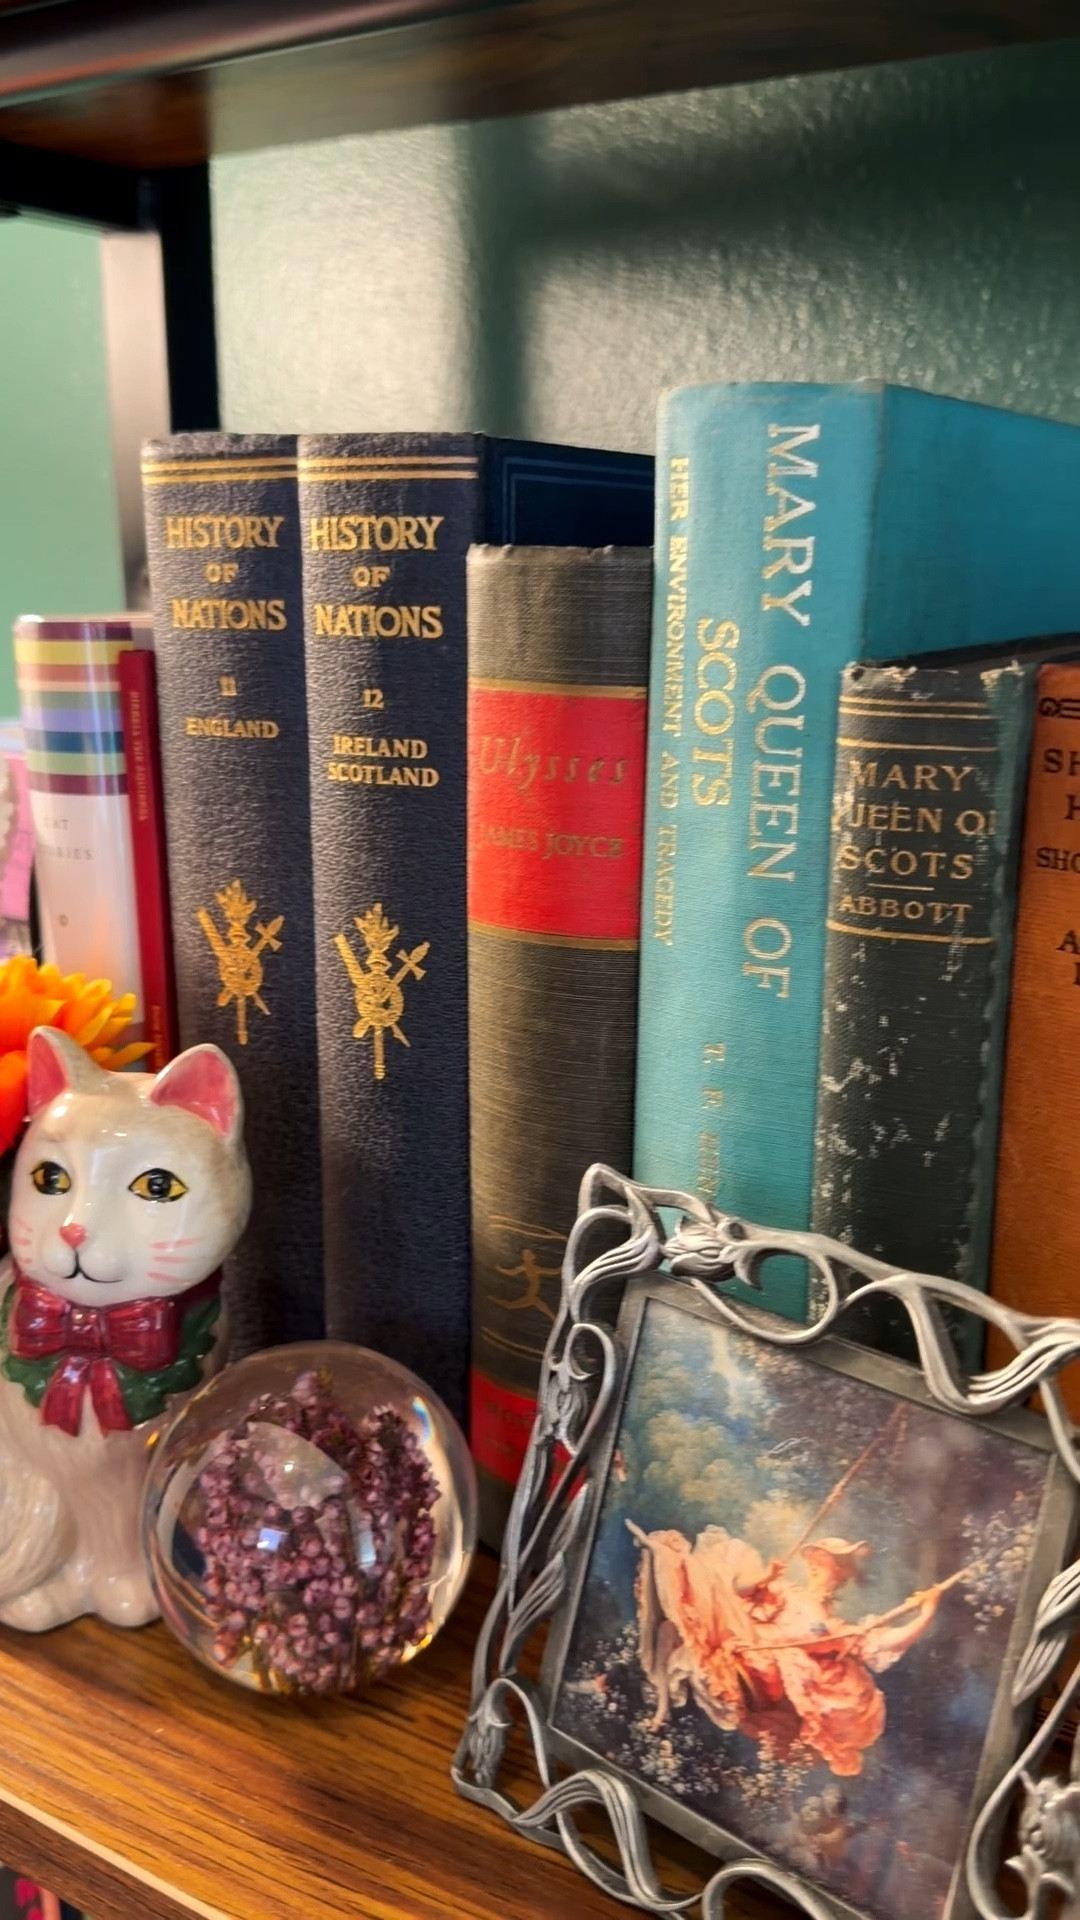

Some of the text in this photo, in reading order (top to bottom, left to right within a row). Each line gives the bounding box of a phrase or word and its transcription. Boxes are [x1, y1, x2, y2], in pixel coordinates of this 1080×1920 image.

[166, 515, 285, 549] HISTORY
[310, 515, 444, 551] HISTORY
[206, 562, 239, 584] OF
[353, 566, 391, 588] OF
[170, 599, 287, 632] NATIONS
[314, 603, 443, 639] NATIONS
[362, 688, 385, 711] 12
[653, 457, 690, 946] HER ENVIRONMENT AND TRAGEDY
[691, 617, 740, 807] SCOTS
[742, 423, 821, 999] MARY QUEEN OF
[185, 717, 280, 740] ENGLAND
[333, 733, 428, 759] IRELAND
[328, 762, 440, 788] SCOTLAND
[479, 735, 627, 800] Ulysses
[848, 760, 976, 792] MARY
[541, 832, 625, 860] JOYCE
[838, 844, 975, 880] SCOTS
[838, 894, 974, 924] ABBOTT
